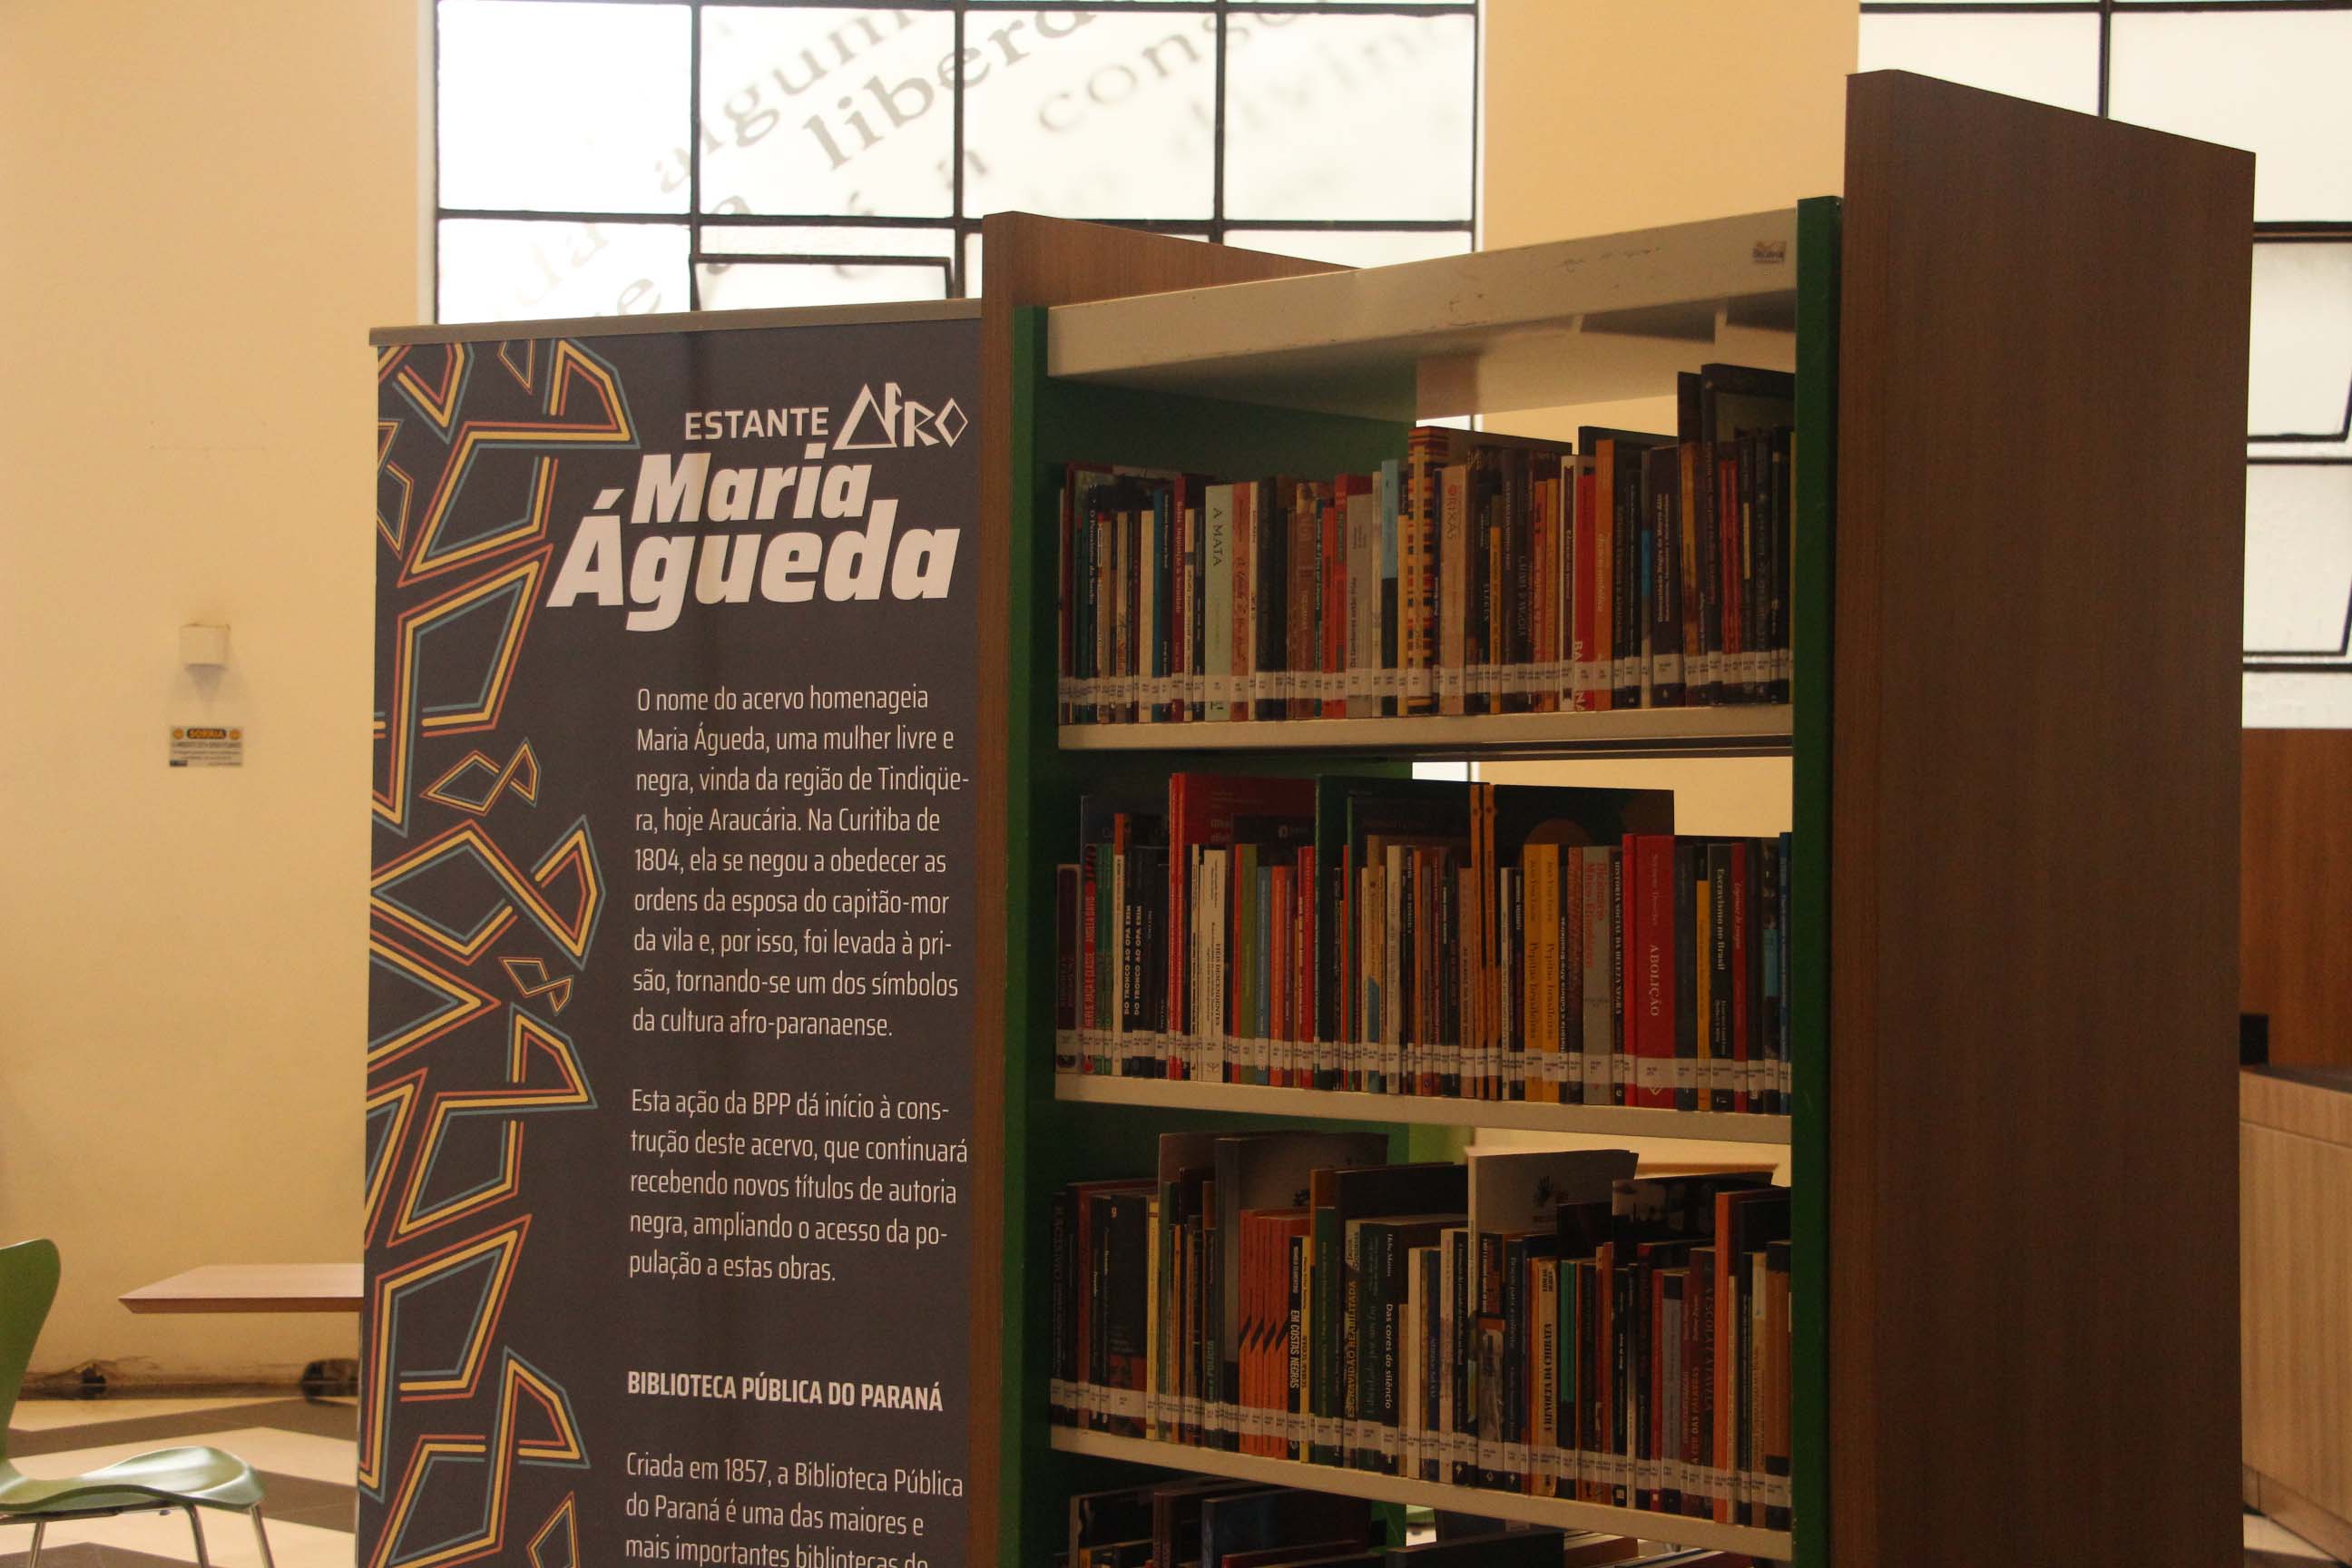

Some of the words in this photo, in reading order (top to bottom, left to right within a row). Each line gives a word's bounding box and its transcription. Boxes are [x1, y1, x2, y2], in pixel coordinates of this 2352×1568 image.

[685, 407, 829, 441] ESTANTE
[631, 443, 873, 524] Maria
[545, 488, 961, 632] Águeda
[1213, 524, 1223, 567] MATA
[636, 688, 651, 711] O
[656, 692, 709, 711] nome
[713, 684, 737, 710] do
[741, 691, 804, 710] acervo
[809, 682, 928, 715] homenageia
[636, 726, 689, 752] Maria
[693, 720, 770, 757] Águeda,
[776, 731, 818, 750] uma
[823, 724, 892, 750] mulher
[897, 723, 937, 750] livre
[943, 730, 955, 750] e
[636, 772, 694, 798] negra,
[699, 765, 750, 791] vinda
[755, 765, 779, 791] da
[784, 765, 843, 797] região
[848, 765, 873, 791] de
[877, 764, 970, 797] Tindiqüe-
[635, 813, 658, 835] ra,
[663, 806, 704, 838] hoje
[708, 806, 802, 831] Araucária.
[808, 808, 833, 832] Na
[838, 806, 910, 832] Curitiba
[916, 806, 941, 832] de
[634, 848, 684, 875] 1804,
[689, 846, 717, 872] ela
[722, 853, 743, 872] se
[749, 853, 808, 878] negou
[813, 853, 825, 872] a
[830, 847, 920, 873] obedecer
[924, 854, 946, 873] as
[633, 886, 699, 912] ordens
[703, 887, 726, 912] da
[731, 894, 798, 918] esposa
[803, 887, 827, 913] do
[832, 887, 950, 919] capitão-mor
[633, 926, 656, 952] da
[662, 926, 693, 952] vila
[699, 934, 715, 956] e,
[720, 934, 752, 958] por
[757, 927, 799, 956] isso,
[803, 928, 828, 954] foi
[833, 928, 896, 955] levada
[901, 929, 913, 956] à
[918, 929, 952, 961] pri-
[632, 967, 671, 995] são,
[675, 967, 790, 994] tornando-se
[796, 975, 826, 995] um
[831, 969, 867, 995] dos
[871, 970, 958, 997] símbolos
[1649, 944, 1661, 1016] ABOLIÇÃO
[632, 1005, 655, 1032] da
[661, 1006, 724, 1034] cultura
[729, 1008, 893, 1041] afro-paranaense.
[631, 1088, 671, 1112] Esta
[675, 1089, 720, 1119] ação
[724, 1089, 747, 1115] da
[752, 1091, 791, 1116] BPP
[796, 1090, 819, 1117] dá
[825, 1092, 875, 1119] início
[879, 1093, 891, 1119] à
[897, 1101, 950, 1121] cons-
[629, 1129, 690, 1159] trução
[694, 1128, 746, 1155] deste
[750, 1137, 818, 1161] acervo,
[824, 1140, 860, 1164] que
[865, 1135, 968, 1164] continuará
[630, 1168, 728, 1195] recebendo
[733, 1177, 789, 1198] novos
[794, 1173, 854, 1200] títulos
[859, 1175, 883, 1201] de
[888, 1178, 956, 1205] autoria
[629, 1214, 688, 1240] negra,
[692, 1211, 793, 1242] ampliando
[798, 1220, 809, 1240] o
[815, 1221, 880, 1242] acesso
[886, 1217, 909, 1244] da
[916, 1226, 948, 1250] po-
[629, 1248, 701, 1280] pulação
[706, 1258, 718, 1277] a
[723, 1255, 773, 1279] estas
[778, 1254, 836, 1282] obras.
[1290, 1309, 1300, 1322] EM
[1290, 1324, 1300, 1354] COSTAS
[1289, 1357, 1300, 1388] NEGRAS
[1385, 1369, 1393, 1409] silêncio
[627, 1370, 738, 1400] BIBLIOTECA
[741, 1371, 824, 1405] PÚBLICA
[828, 1381, 856, 1406] DO
[860, 1380, 944, 1412] PARANÁ
[626, 1451, 684, 1478] Criada
[689, 1460, 719, 1481] em
[723, 1457, 772, 1488] 1857,
[777, 1465, 789, 1485] a
[795, 1461, 887, 1492] Biblioteca
[894, 1468, 964, 1498] Pública
[625, 1491, 650, 1517] do
[654, 1494, 720, 1522] Paraná
[725, 1497, 737, 1524] é
[742, 1504, 784, 1526] uma
[789, 1502, 824, 1529] das
[829, 1505, 907, 1535] maiores
[912, 1517, 924, 1536] e
[625, 1533, 671, 1560] mais
[675, 1534, 790, 1568] importantes
[795, 1543, 898, 1568] bibliotecas
